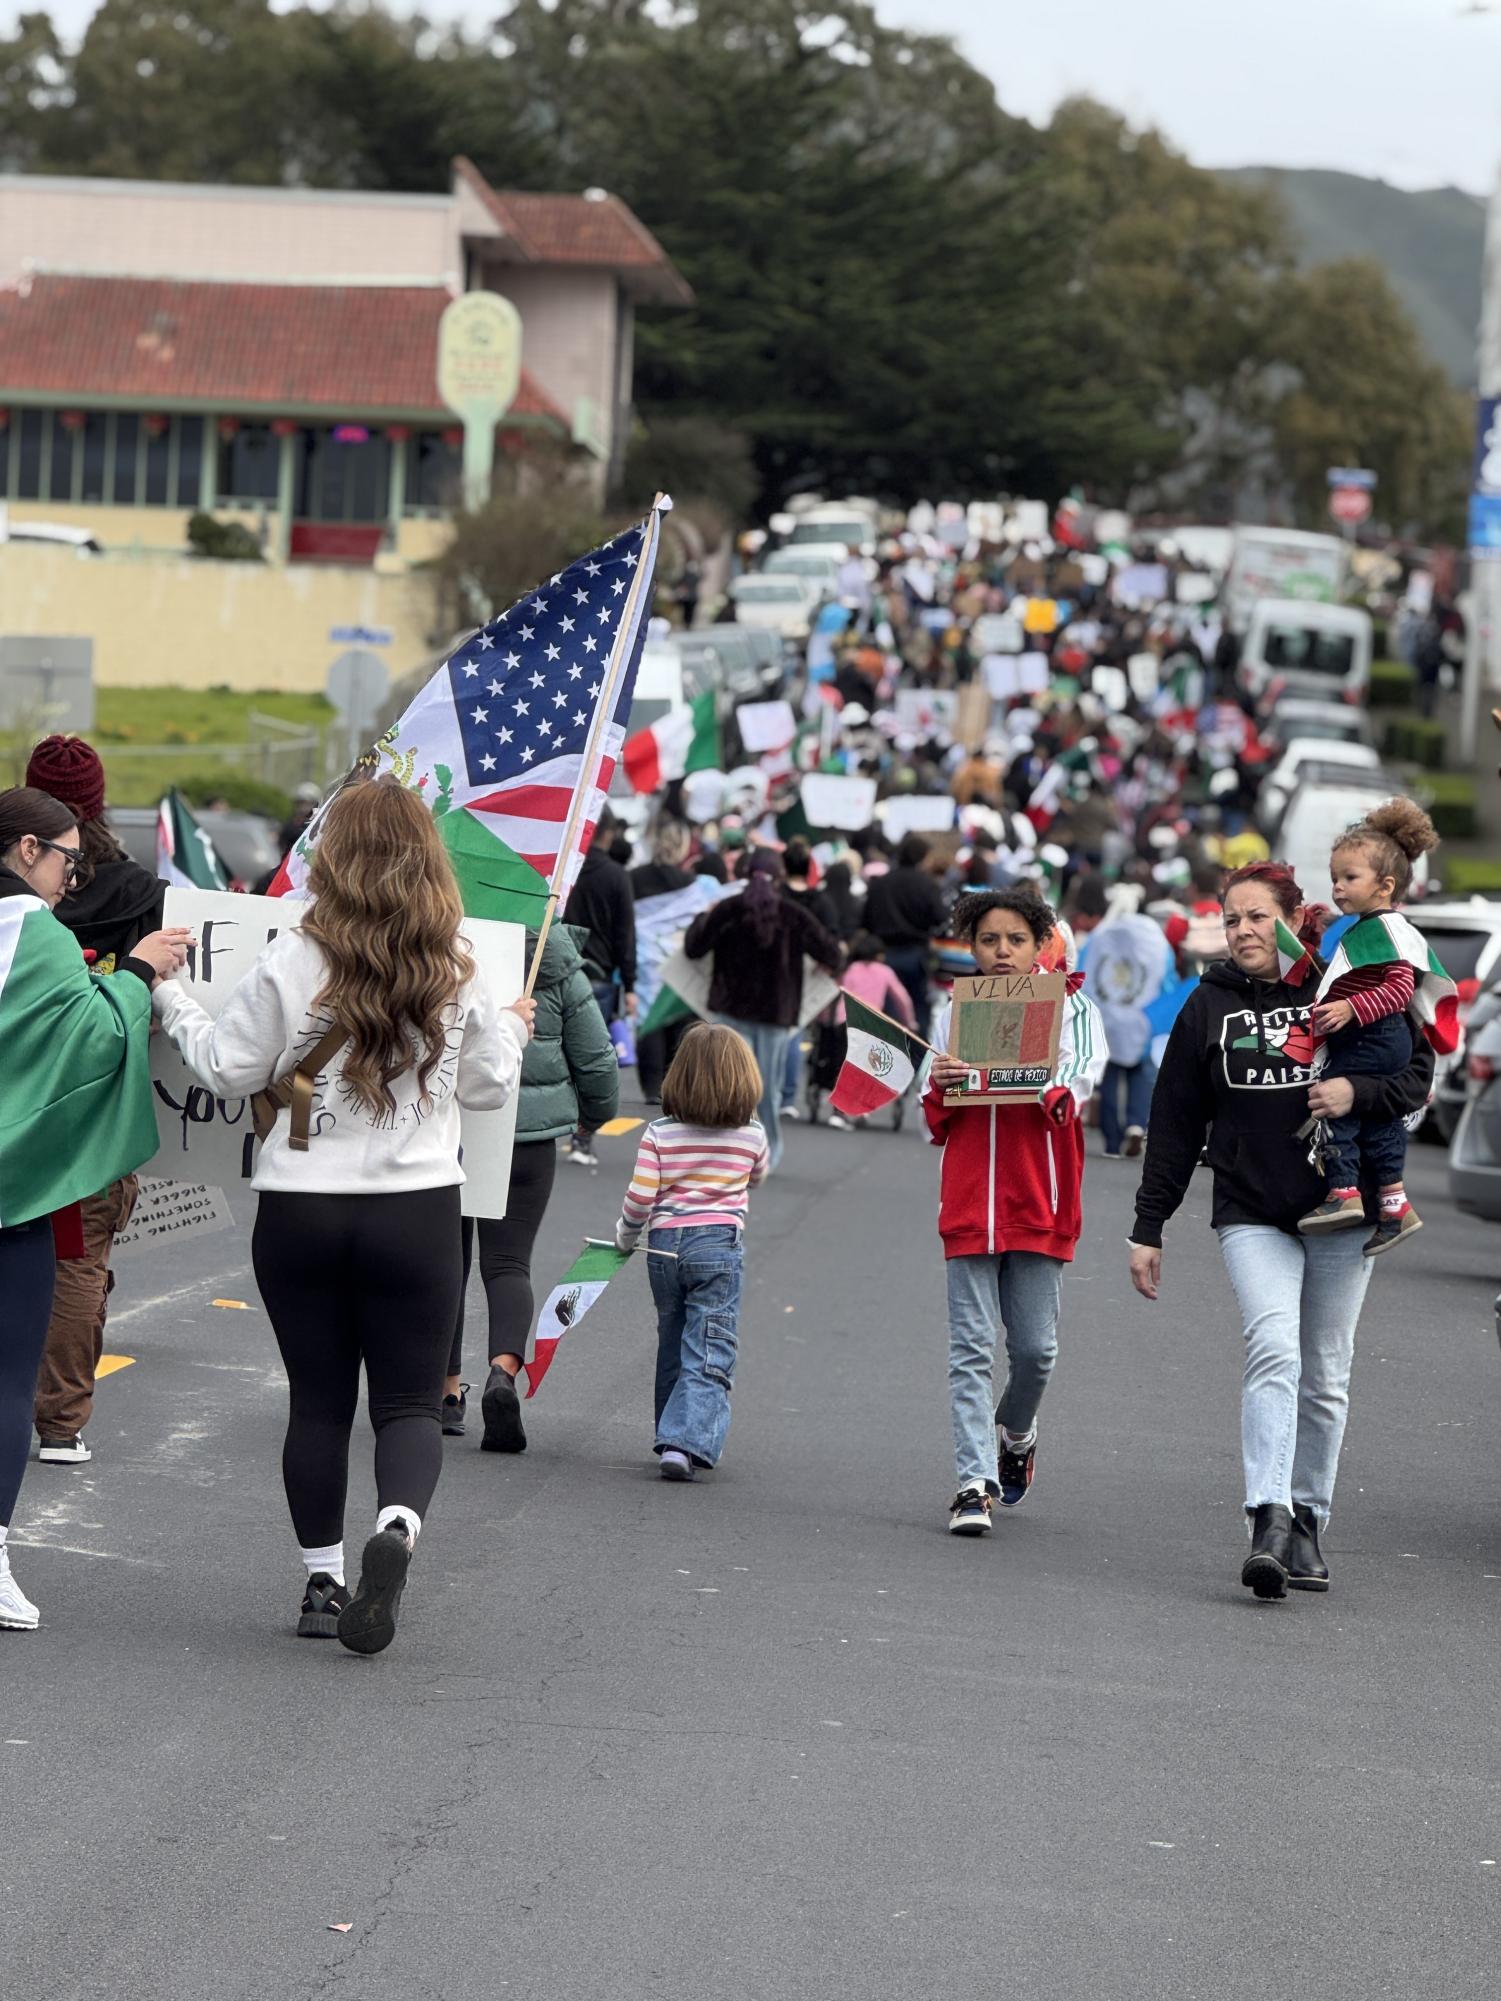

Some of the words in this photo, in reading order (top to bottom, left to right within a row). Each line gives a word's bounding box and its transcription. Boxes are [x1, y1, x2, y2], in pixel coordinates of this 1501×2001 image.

[972, 976, 1034, 998] VIVA
[1244, 1010, 1311, 1026] HELLA
[150, 1185, 207, 1206] BIGGER
[131, 1198, 212, 1227] SOMETHING
[148, 1211, 217, 1236] FIGHTING
[113, 1232, 140, 1246] FOR
